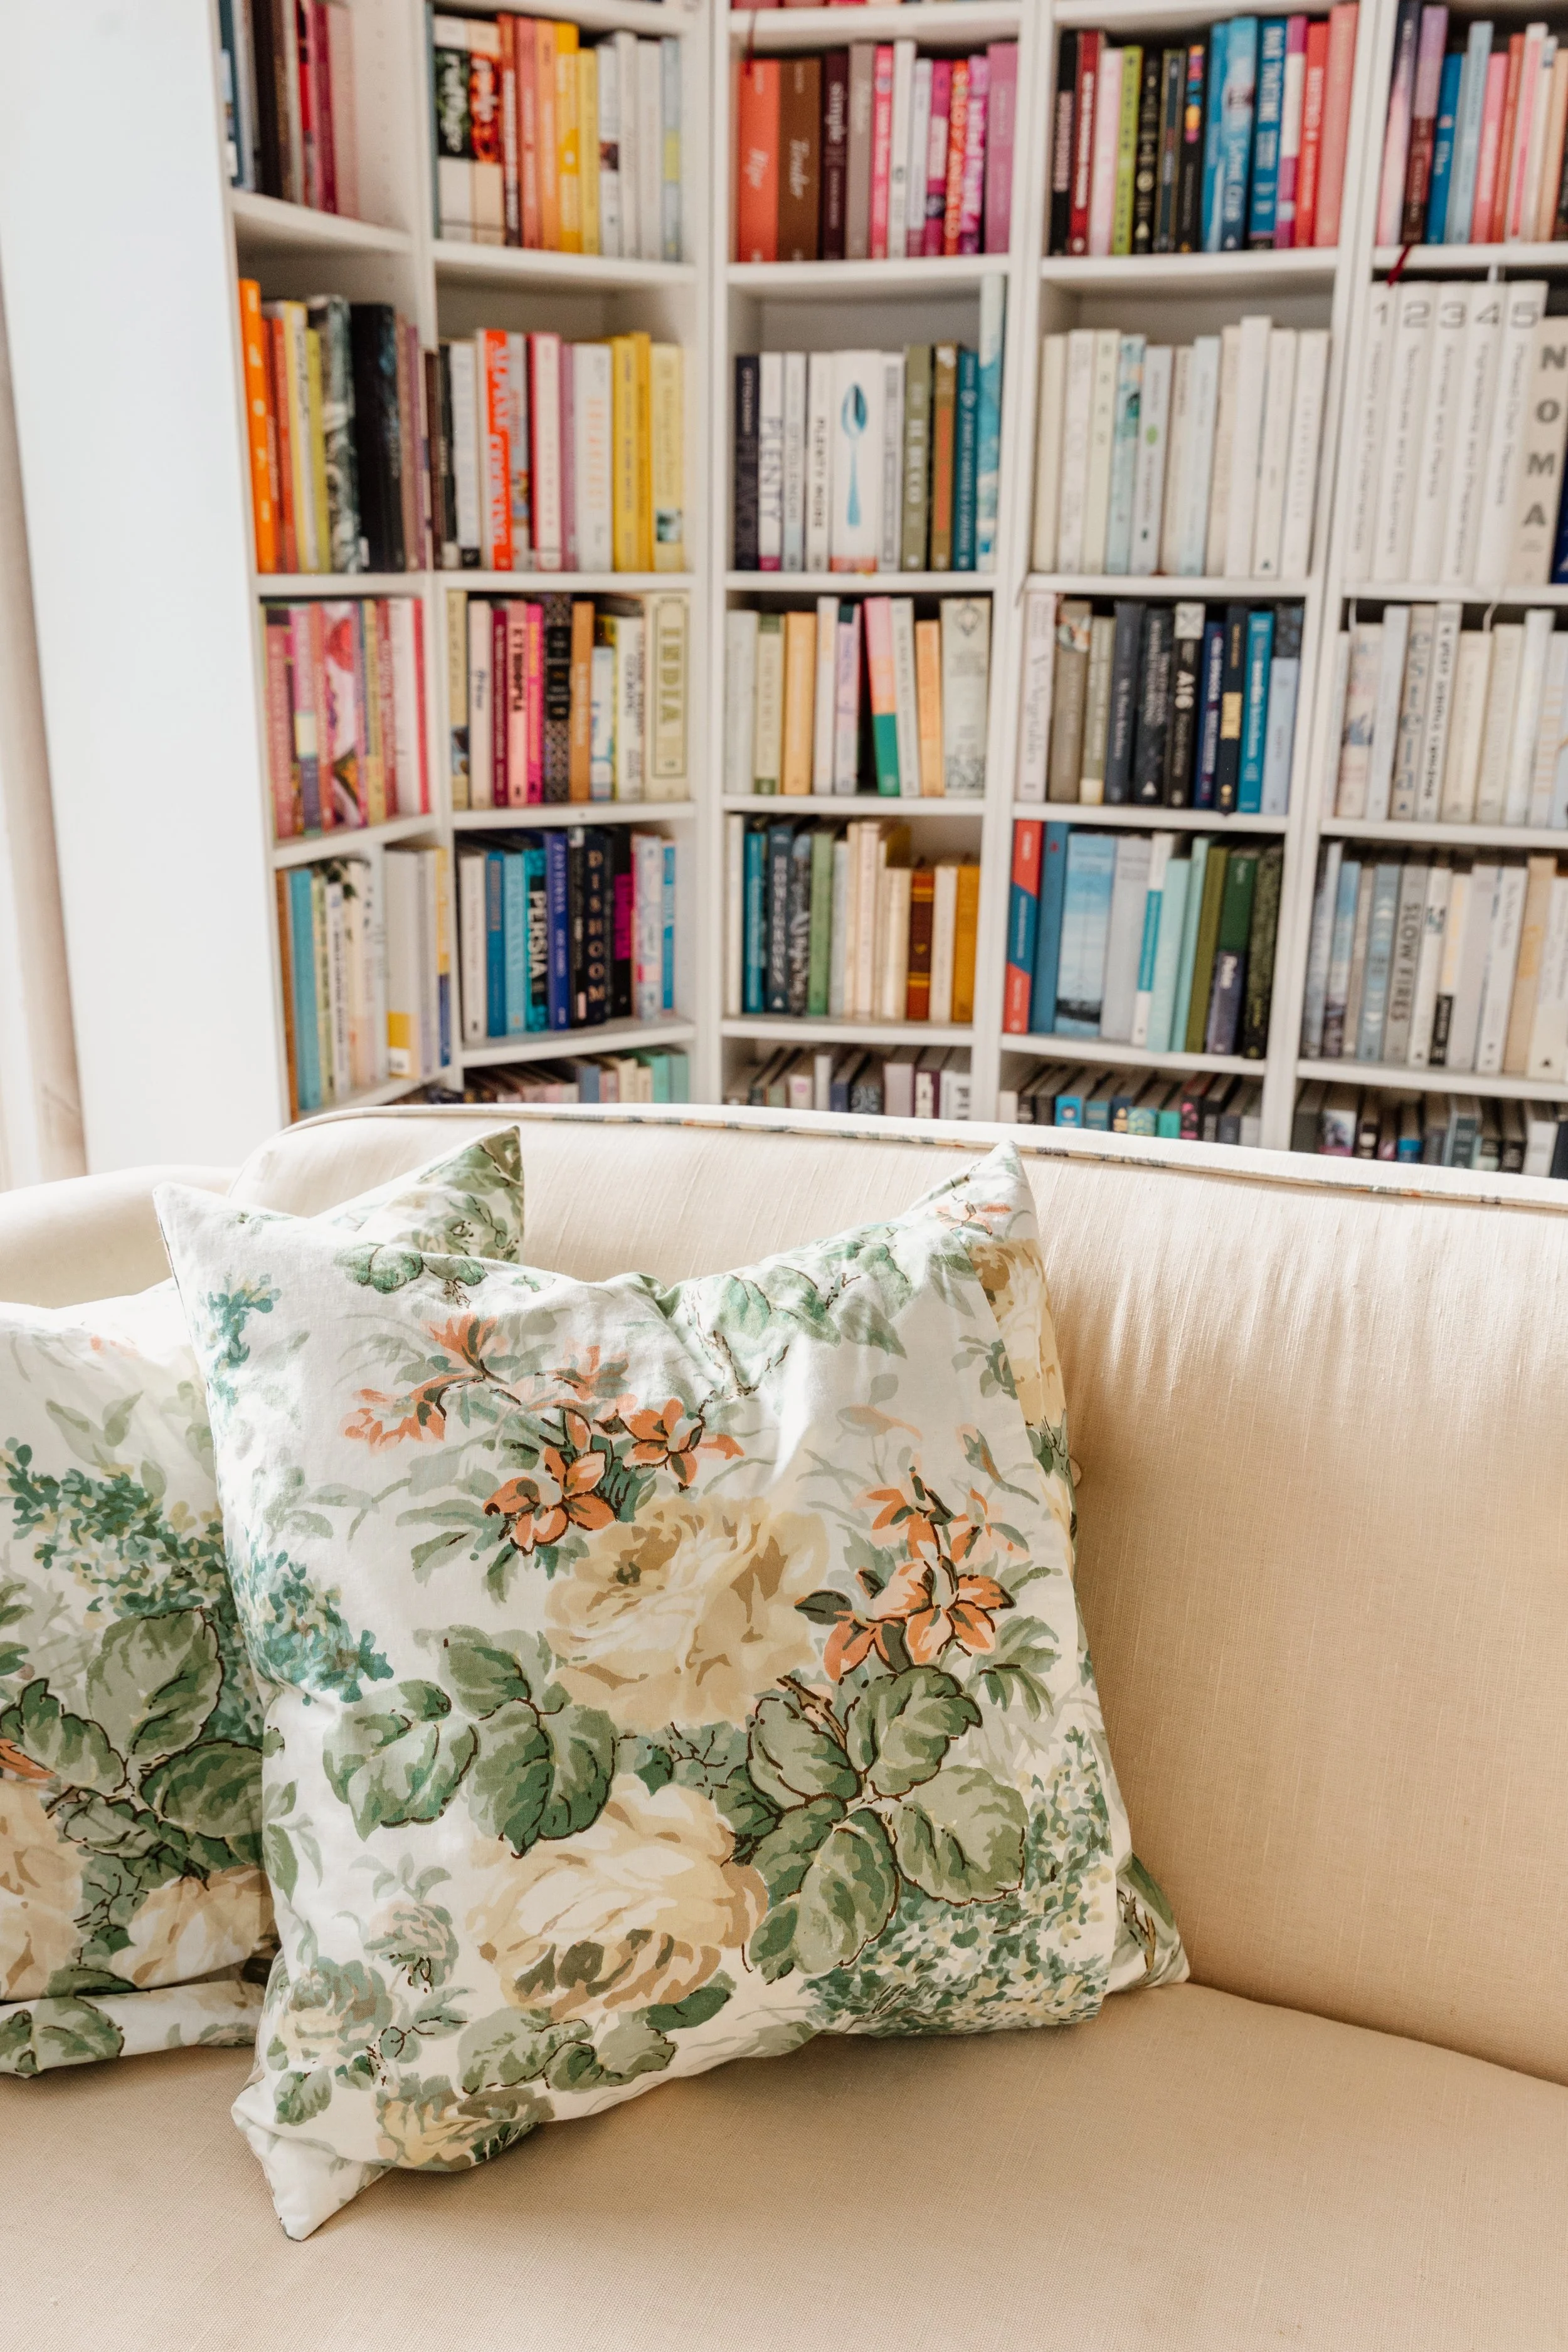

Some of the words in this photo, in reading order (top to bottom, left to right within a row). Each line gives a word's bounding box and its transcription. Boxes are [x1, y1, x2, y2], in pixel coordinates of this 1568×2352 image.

[1374, 301, 1388, 326] 1
[1402, 301, 1431, 329] 2
[1439, 301, 1467, 329] 3
[1475, 302, 1501, 326] 4
[1509, 301, 1540, 330] 5
[1520, 346, 1567, 528] NOMA
[760, 416, 781, 524] PLENTY
[660, 627, 683, 725] INDIA
[1175, 670, 1195, 710] A16
[528, 890, 546, 979] PERSIA
[588, 849, 606, 1004] DISHOOM
[1399, 902, 1420, 962] SLOW
[1391, 967, 1412, 1021] FIRES
